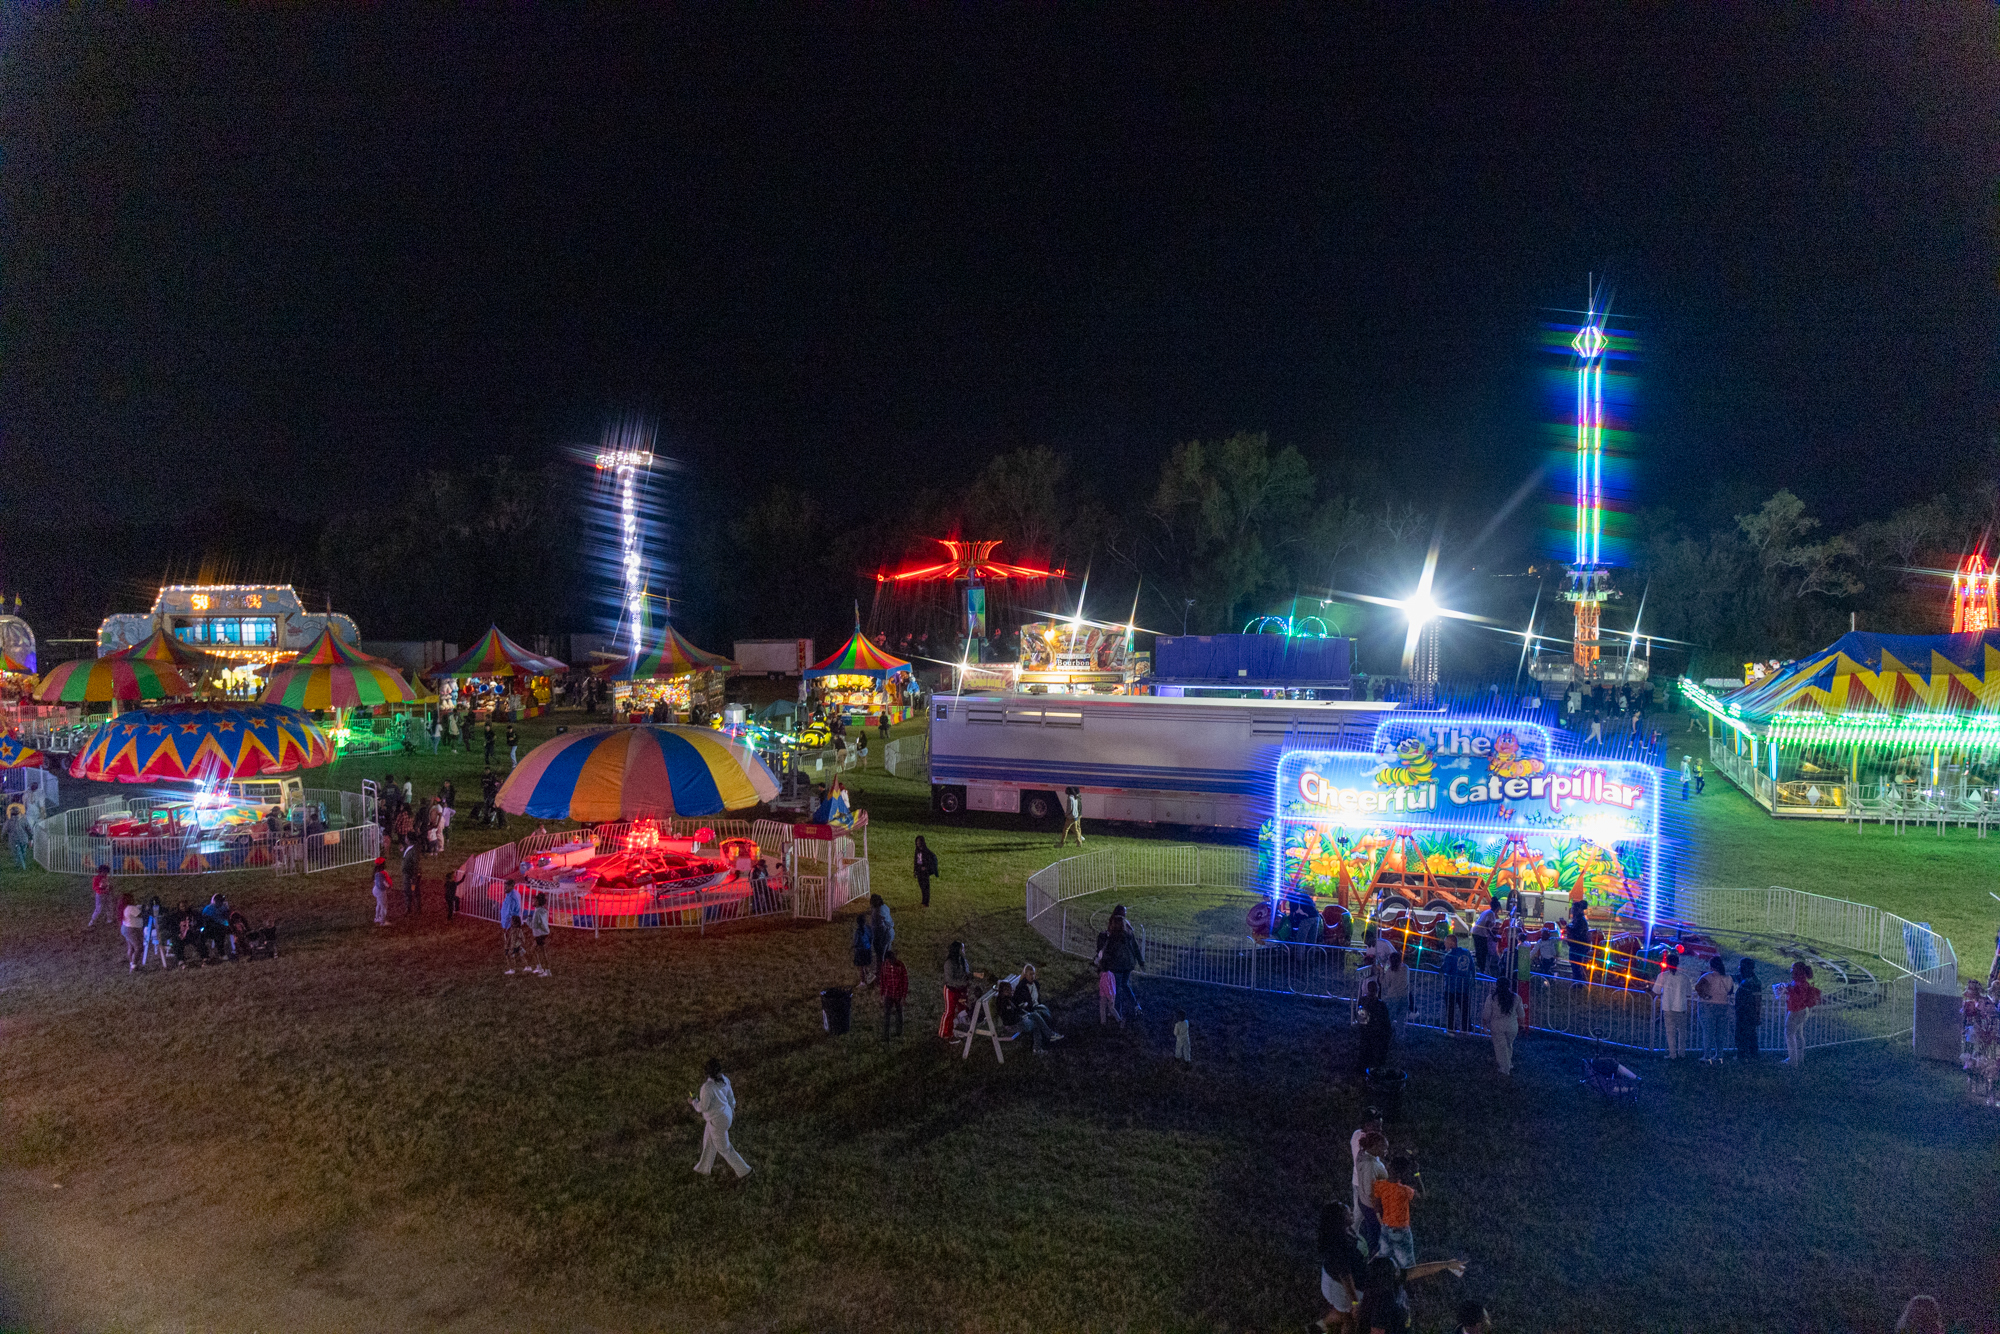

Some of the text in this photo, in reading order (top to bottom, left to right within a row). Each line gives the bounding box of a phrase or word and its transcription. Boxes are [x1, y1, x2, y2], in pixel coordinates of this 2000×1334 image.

[1431, 726, 1492, 758] The
[1299, 767, 1643, 813] Cheerful Caterpillar
